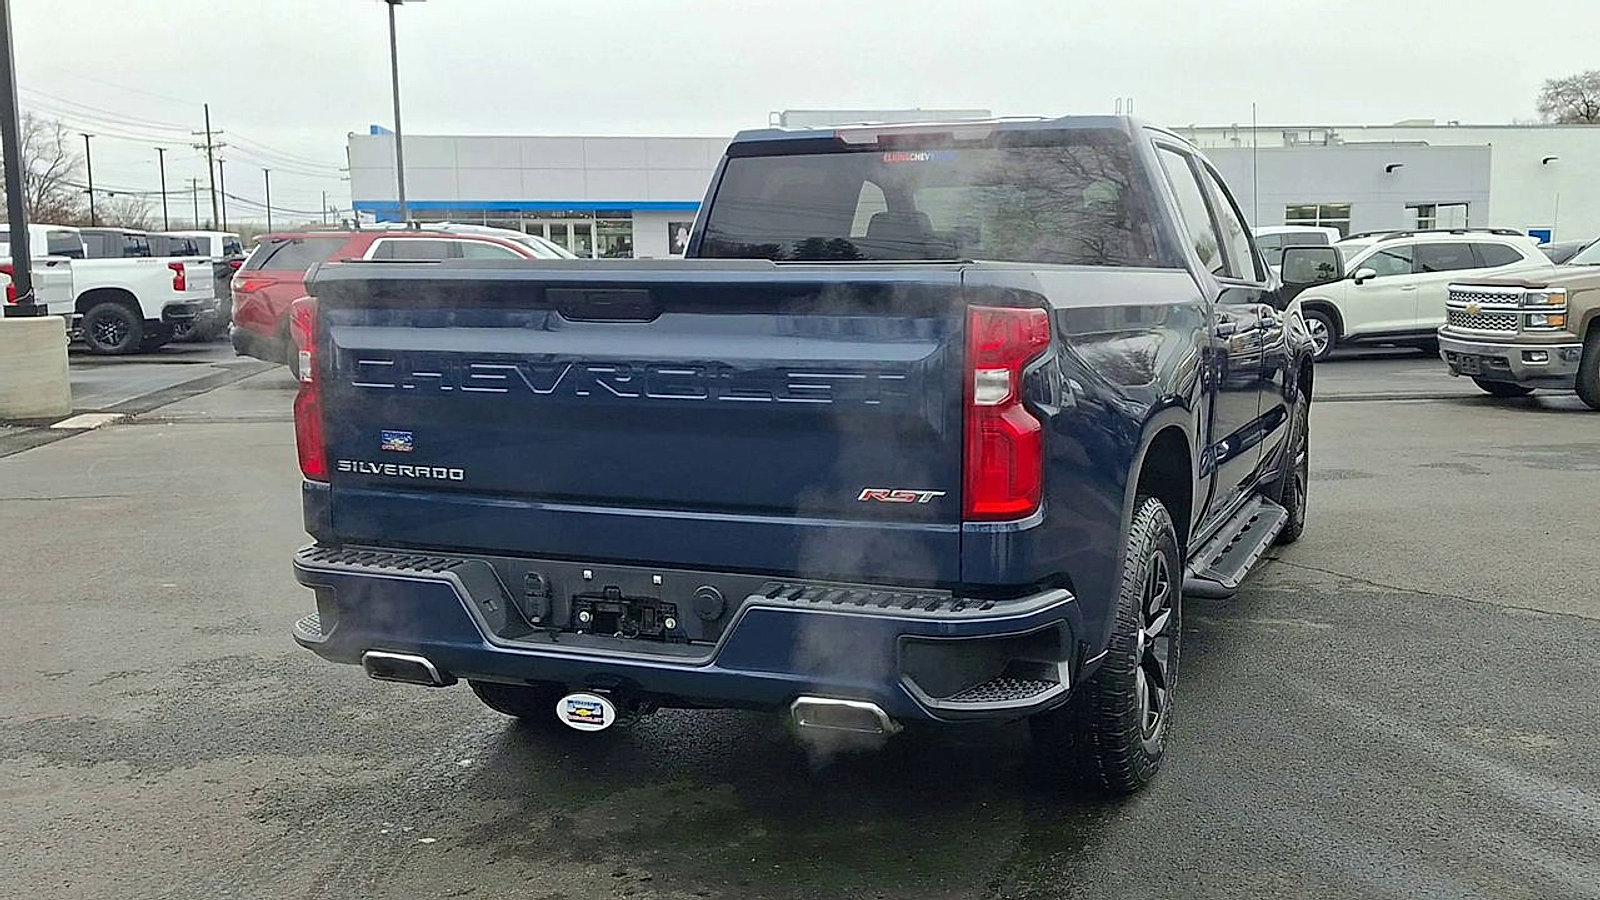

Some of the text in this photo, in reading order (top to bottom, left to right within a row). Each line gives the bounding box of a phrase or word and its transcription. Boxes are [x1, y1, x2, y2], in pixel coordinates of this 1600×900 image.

[352, 359, 908, 405] CHEVROLET
[337, 459, 465, 481] SILVERADO
[857, 488, 947, 503] RST
